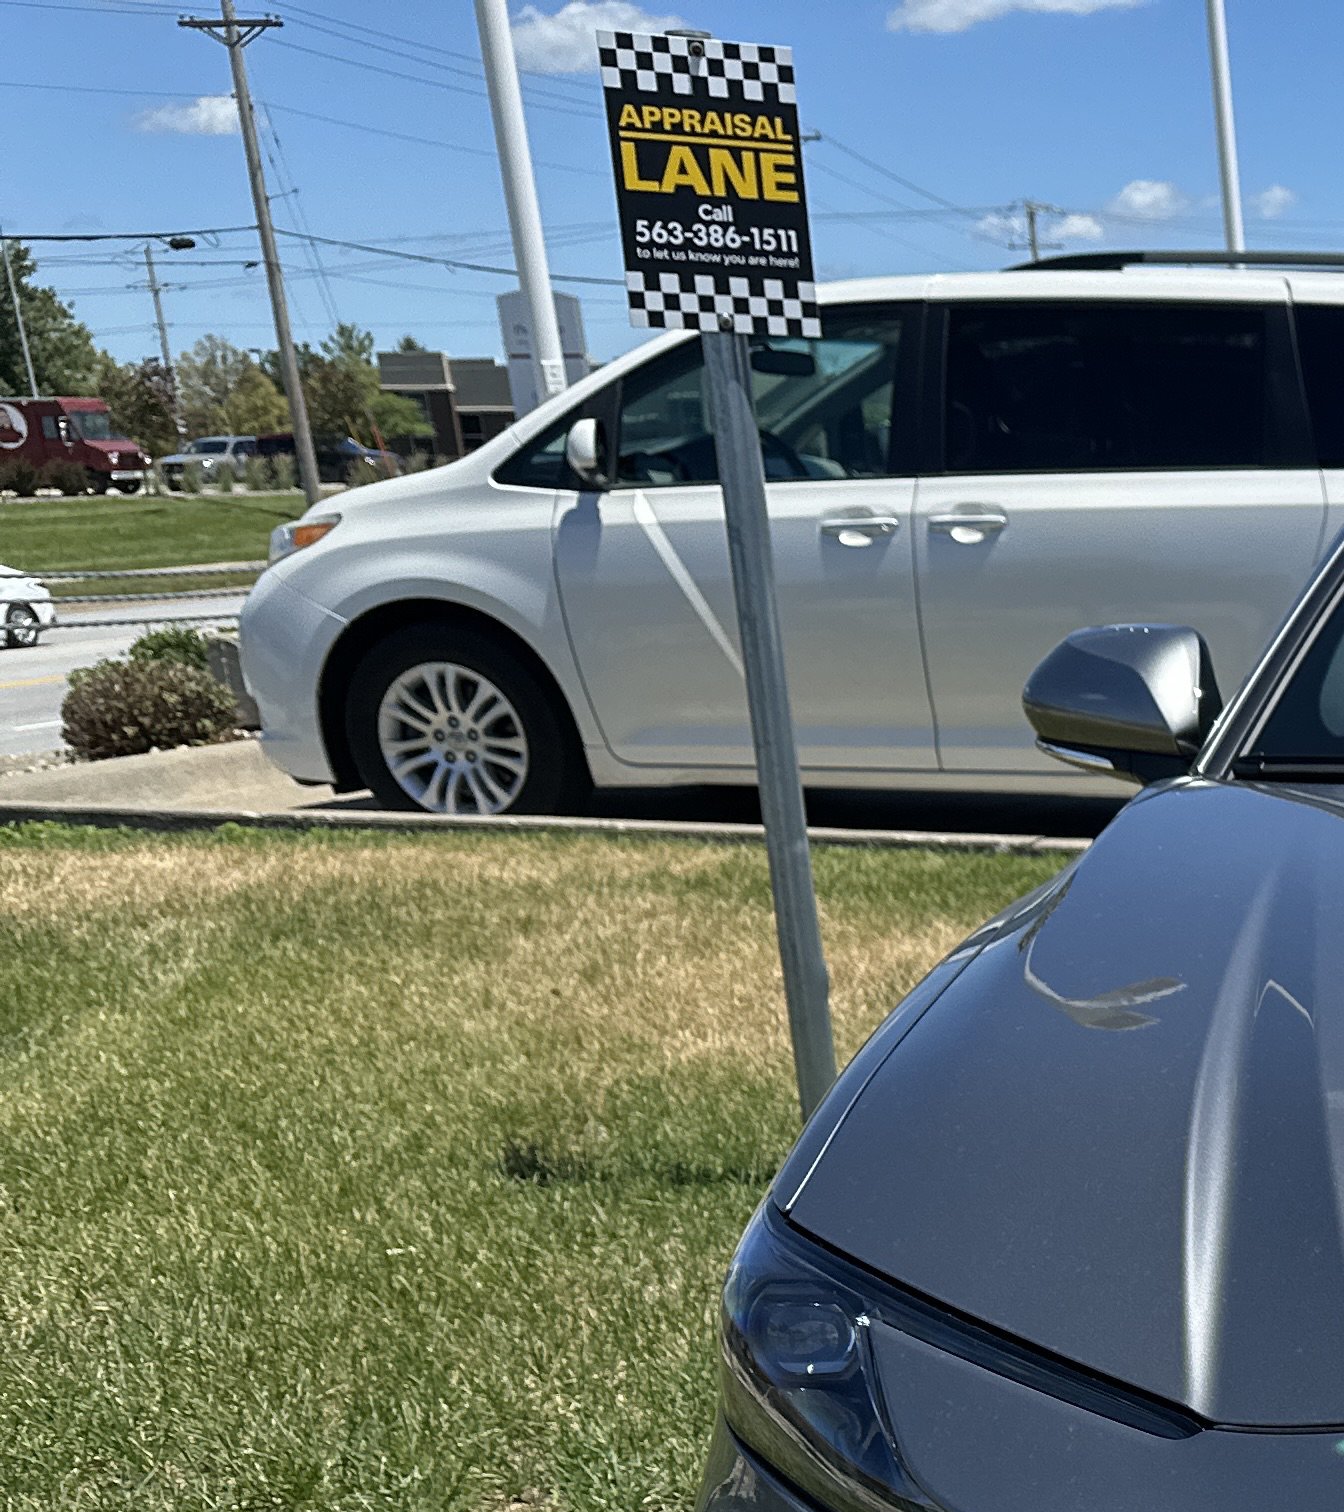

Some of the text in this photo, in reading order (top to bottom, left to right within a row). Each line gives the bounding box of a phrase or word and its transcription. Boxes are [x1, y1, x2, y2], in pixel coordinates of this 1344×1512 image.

[618, 103, 794, 141] APPRAISAL
[619, 141, 800, 203] LANE
[698, 203, 734, 222] Call
[635, 219, 799, 252] 563-386-1511
[636, 247, 800, 269] to let us know you are here!
